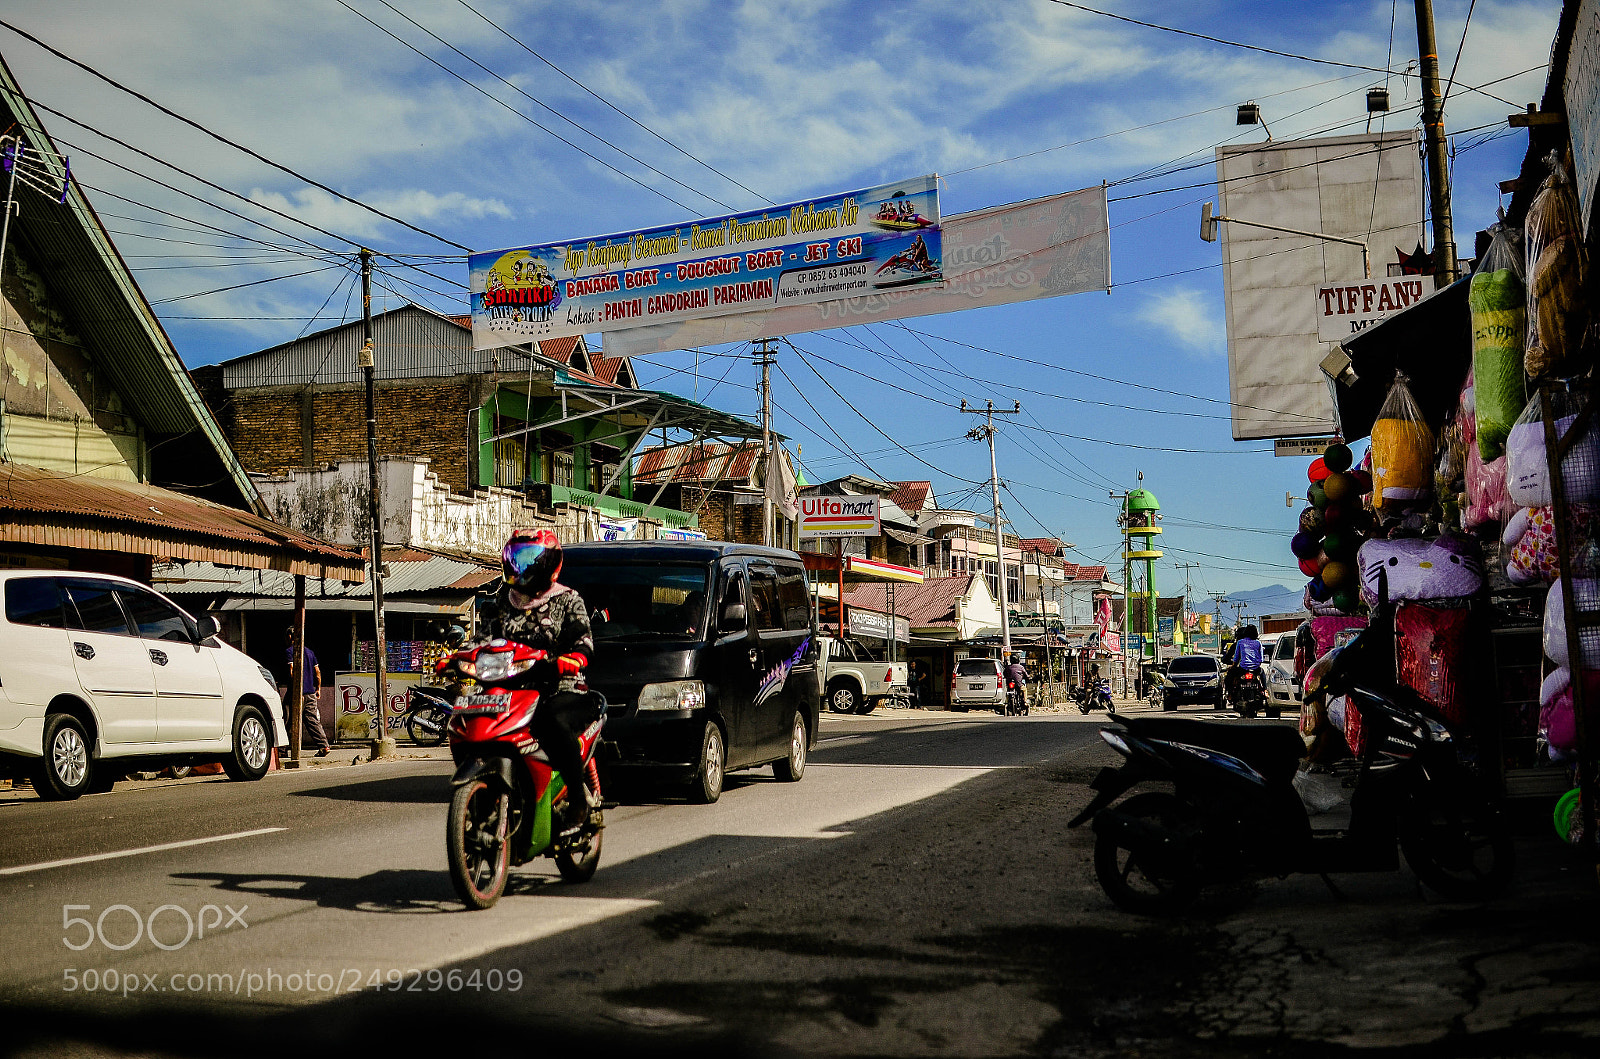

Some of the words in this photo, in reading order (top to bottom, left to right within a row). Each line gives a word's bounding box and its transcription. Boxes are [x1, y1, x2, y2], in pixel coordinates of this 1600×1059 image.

[564, 244, 584, 277] Ayo
[587, 235, 634, 271] Kunjungi
[635, 228, 681, 260] Beramai
[691, 220, 728, 251] Ramai
[729, 213, 788, 246] Permainan
[791, 203, 838, 235] Wahana
[841, 197, 859, 228] Air
[566, 275, 620, 299] BANANA
[625, 269, 660, 290] BOAT
[677, 257, 741, 281] DOUGNUT
[746, 250, 783, 271] BOAT
[804, 243, 830, 262] JET
[837, 237, 862, 257] SKI
[808, 269, 826, 283] 0852
[828, 268, 837, 280] 63
[839, 264, 866, 278] 404040
[566, 305, 595, 327] Lokasi
[604, 298, 642, 321] PANTAI
[647, 288, 709, 315] GANDORIAH
[713, 278, 773, 306] PARIAMAN
[1318, 280, 1423, 316] TIFFANY
[485, 303, 514, 321] WATER
[520, 303, 556, 323] SPORTS
[802, 498, 874, 516] Ulfamart
[1386, 735, 1418, 750] HONDA
